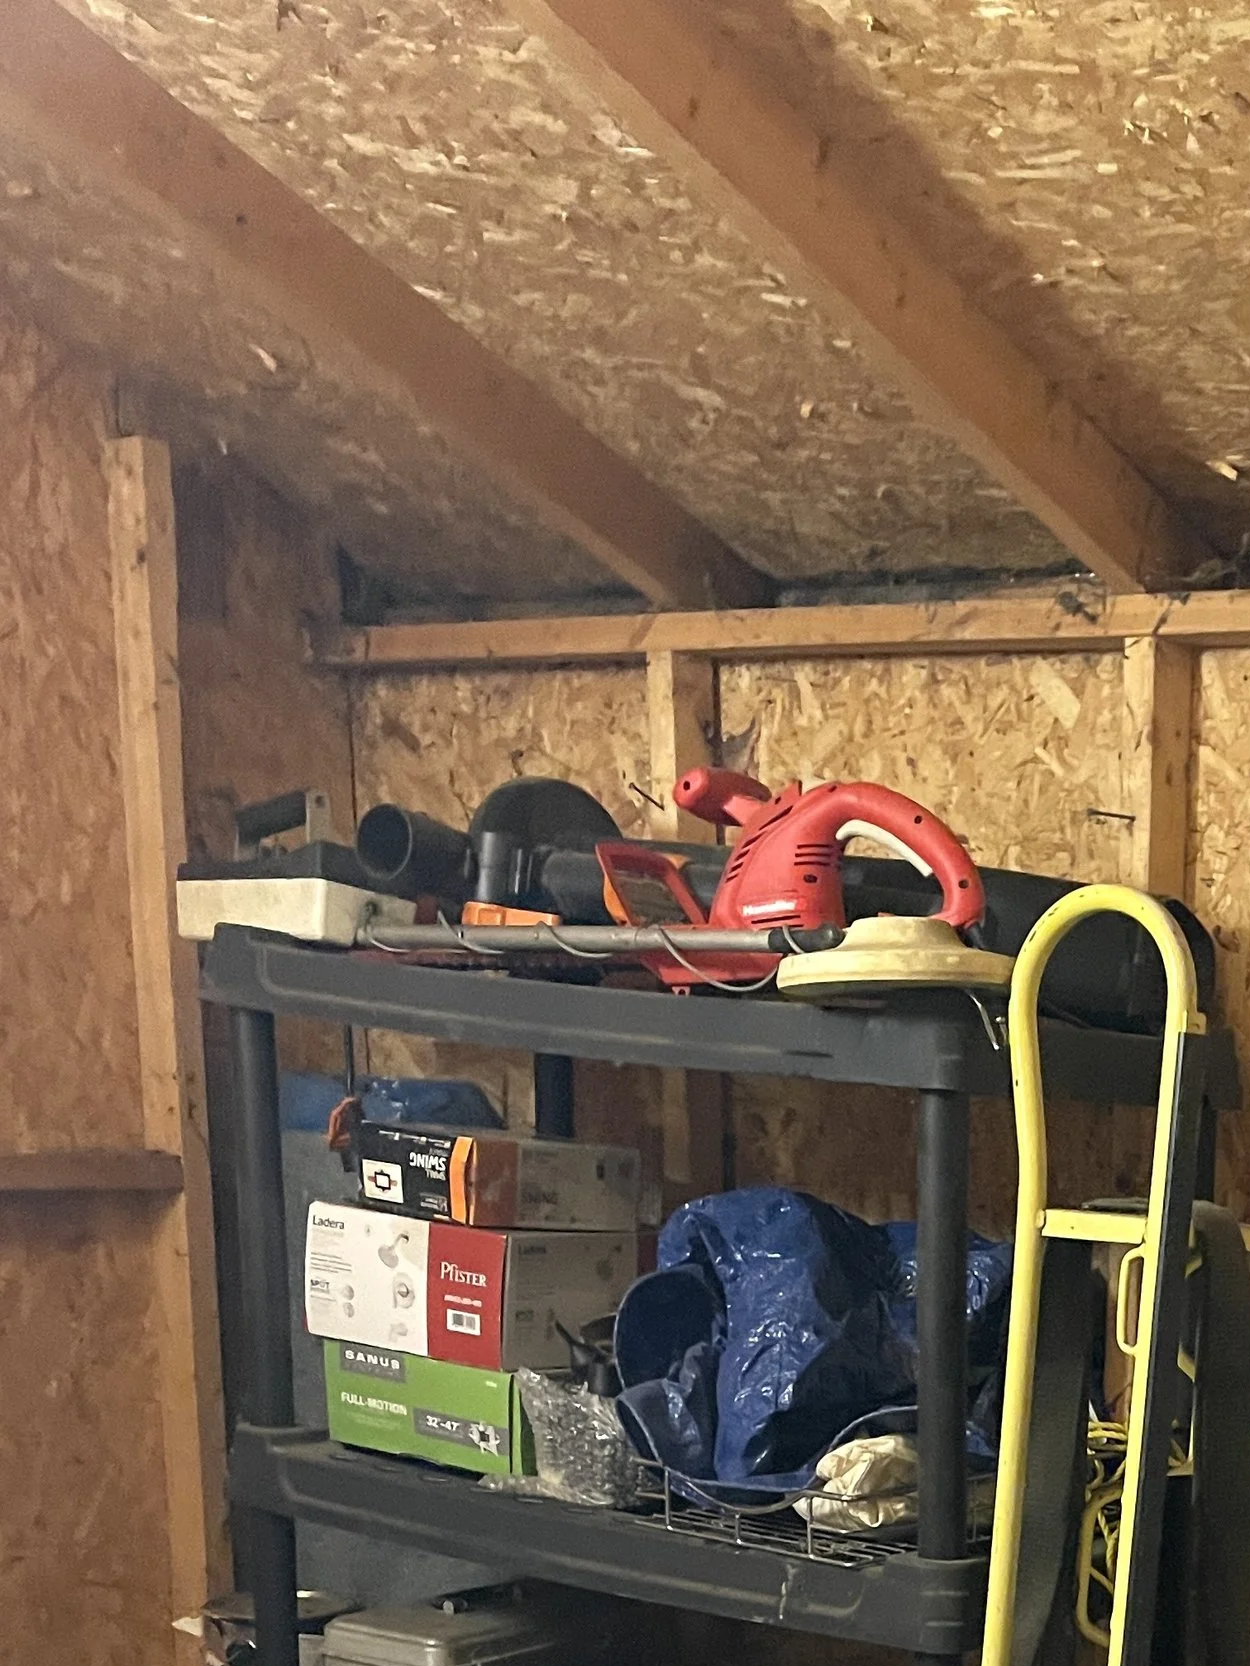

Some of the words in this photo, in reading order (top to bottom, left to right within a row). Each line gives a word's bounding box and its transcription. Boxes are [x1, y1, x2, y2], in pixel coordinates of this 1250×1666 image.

[409, 1152, 448, 1172] SWING
[312, 1214, 345, 1231] Ladera
[345, 1350, 401, 1370] SANUS
[340, 1391, 408, 1416] FULL-MOTION
